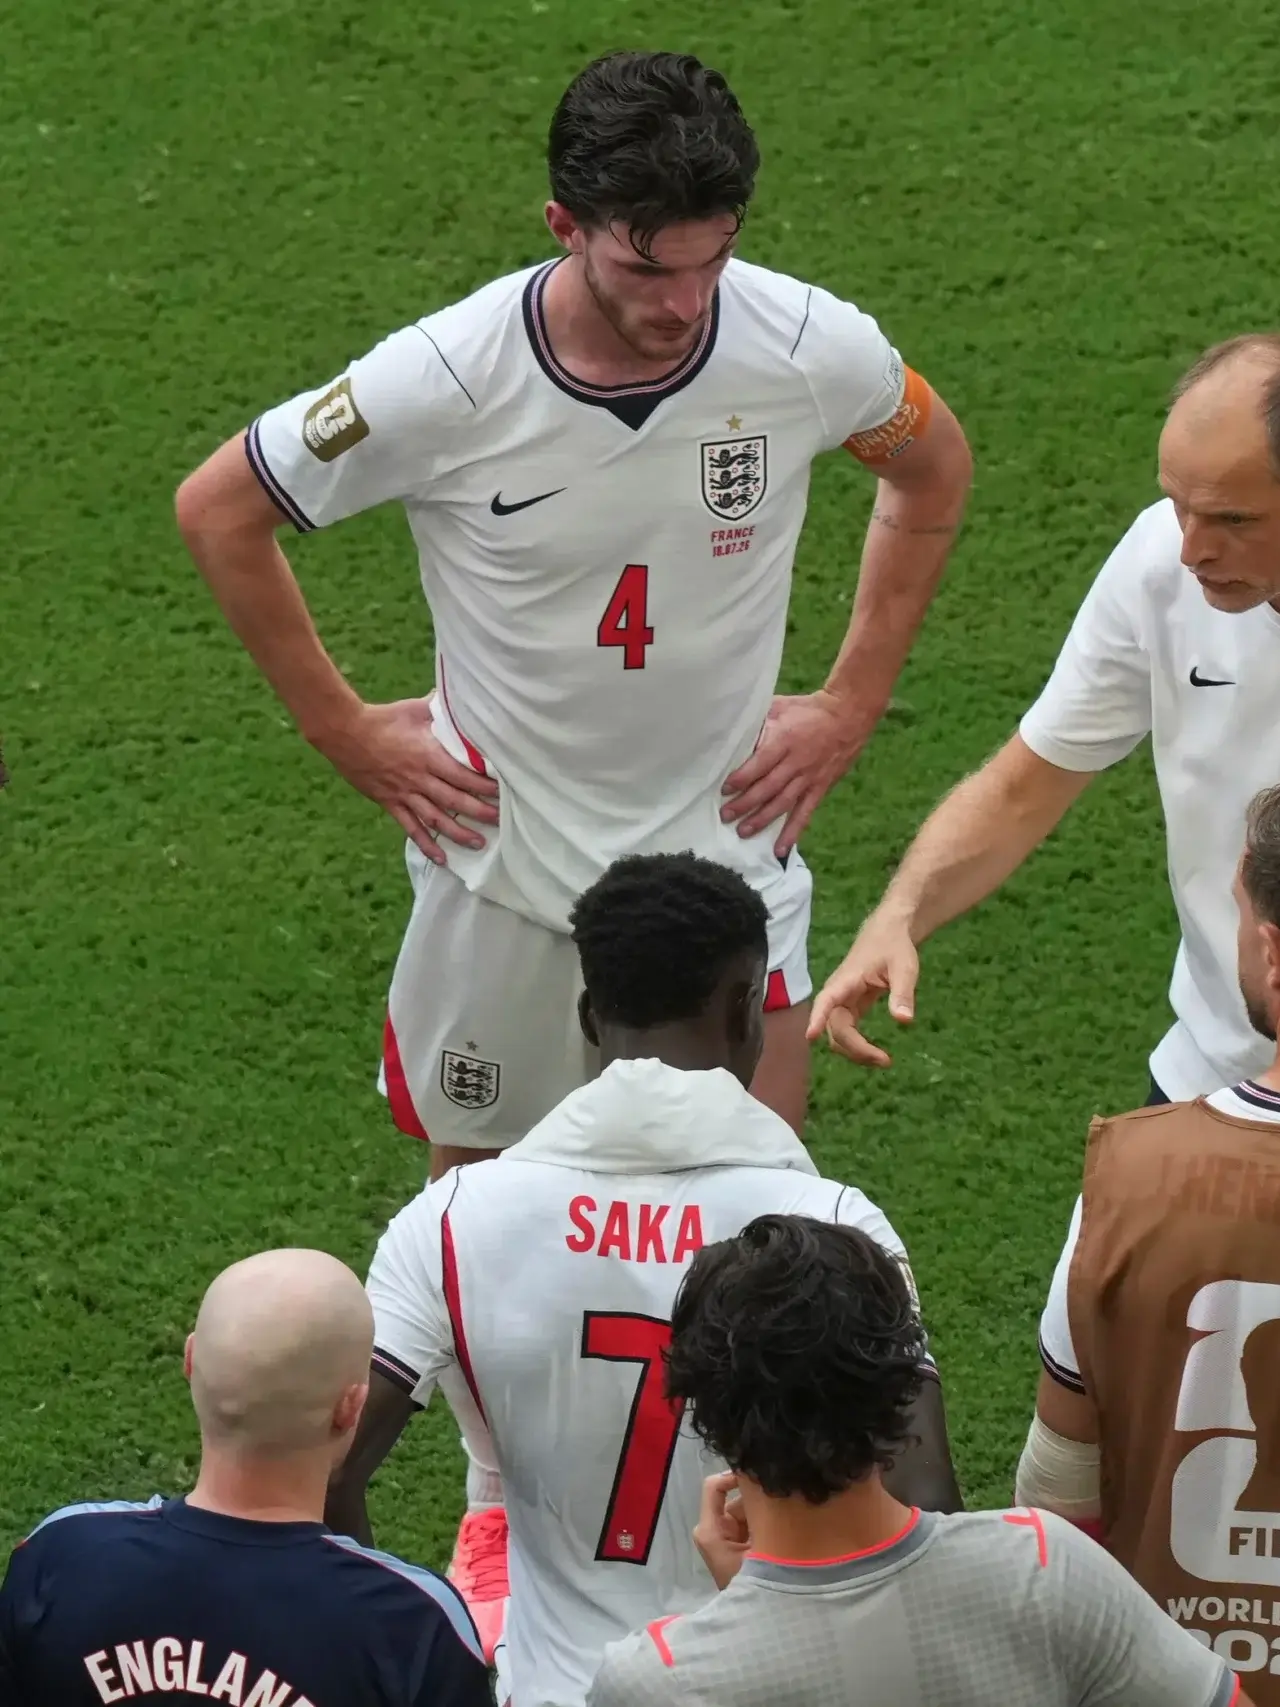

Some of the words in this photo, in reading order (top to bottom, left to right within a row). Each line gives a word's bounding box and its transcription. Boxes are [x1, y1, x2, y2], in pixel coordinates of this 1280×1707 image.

[711, 526, 756, 542] FRANCE
[597, 564, 654, 670] 4
[565, 1195, 704, 1264] SAKA
[580, 1310, 687, 1566] 7
[83, 1636, 316, 1707] ENGLAN
